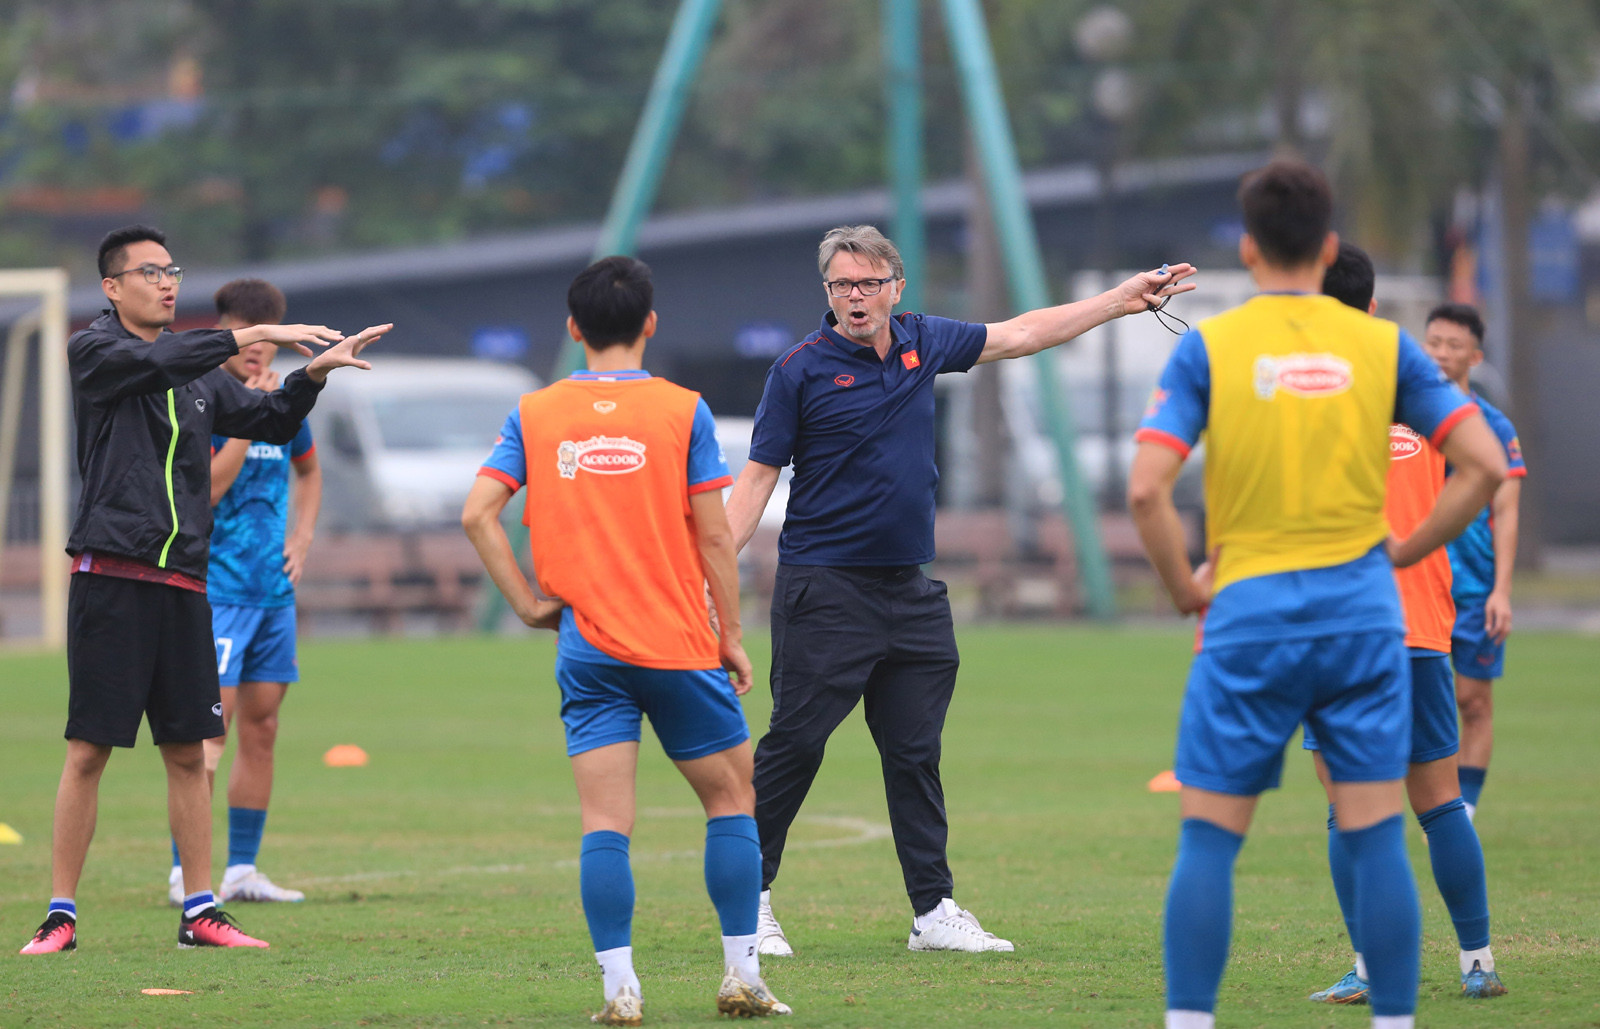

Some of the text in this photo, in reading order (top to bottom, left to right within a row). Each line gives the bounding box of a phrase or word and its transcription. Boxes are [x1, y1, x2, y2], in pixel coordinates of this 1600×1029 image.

[1389, 425, 1419, 438] ppiness
[246, 445, 284, 459] NDA
[215, 637, 232, 675] 7
